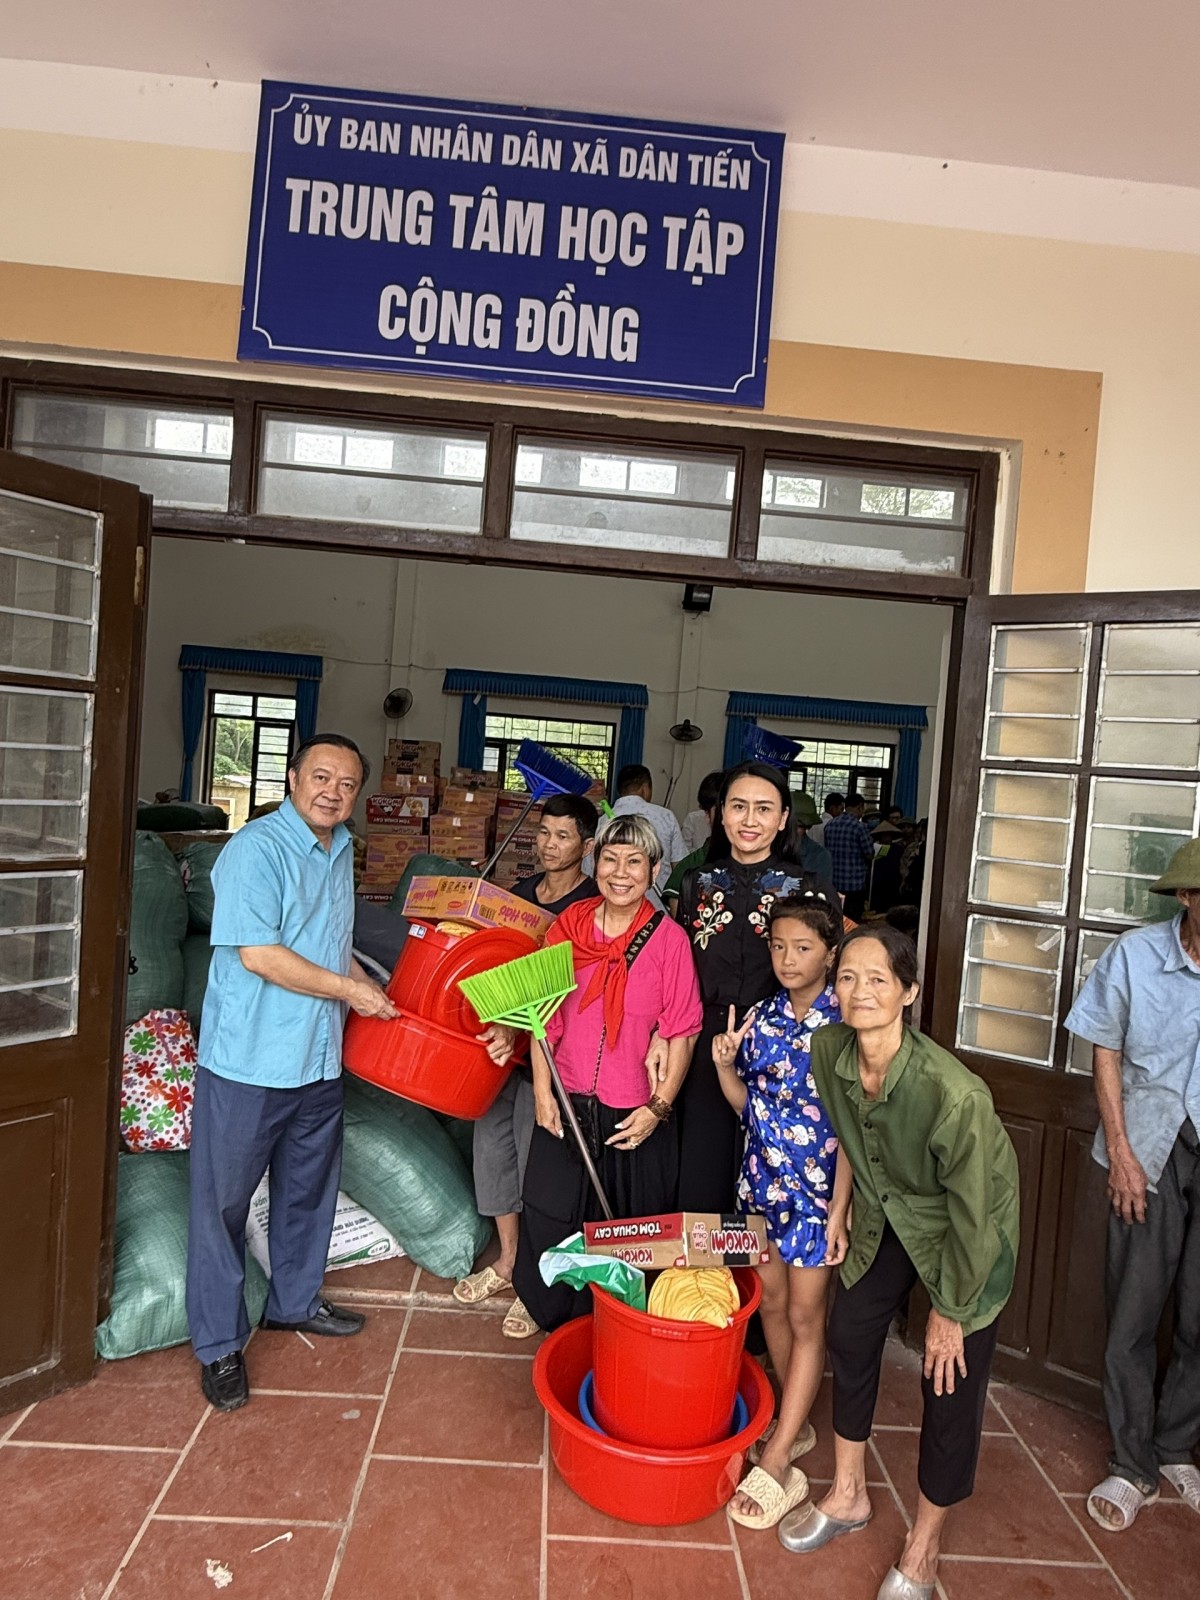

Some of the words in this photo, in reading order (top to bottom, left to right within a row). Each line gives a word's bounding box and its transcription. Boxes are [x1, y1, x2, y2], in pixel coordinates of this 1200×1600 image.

[293, 103, 330, 147] ỦY
[340, 117, 401, 155] BAN
[410, 123, 493, 164] NHÂN
[502, 131, 562, 171] DÂN
[571, 138, 609, 176] XÃ
[618, 143, 678, 183] DÂN
[688, 148, 751, 191] TIẾN
[285, 178, 434, 246] TRUNG
[449, 186, 545, 257] TÂM
[557, 206, 648, 276] HỌC
[663, 208, 745, 286] TẬP
[377, 276, 502, 355] CỘNG
[515, 283, 639, 363] ĐỒNG
[521, 911, 540, 928] Hảo
[626, 922, 654, 965] CHANE
[593, 1227, 612, 1239] CAY
[613, 1224, 638, 1238] CHUA
[639, 1222, 662, 1237] TÔM
[711, 1229, 759, 1254] KOKOMI
